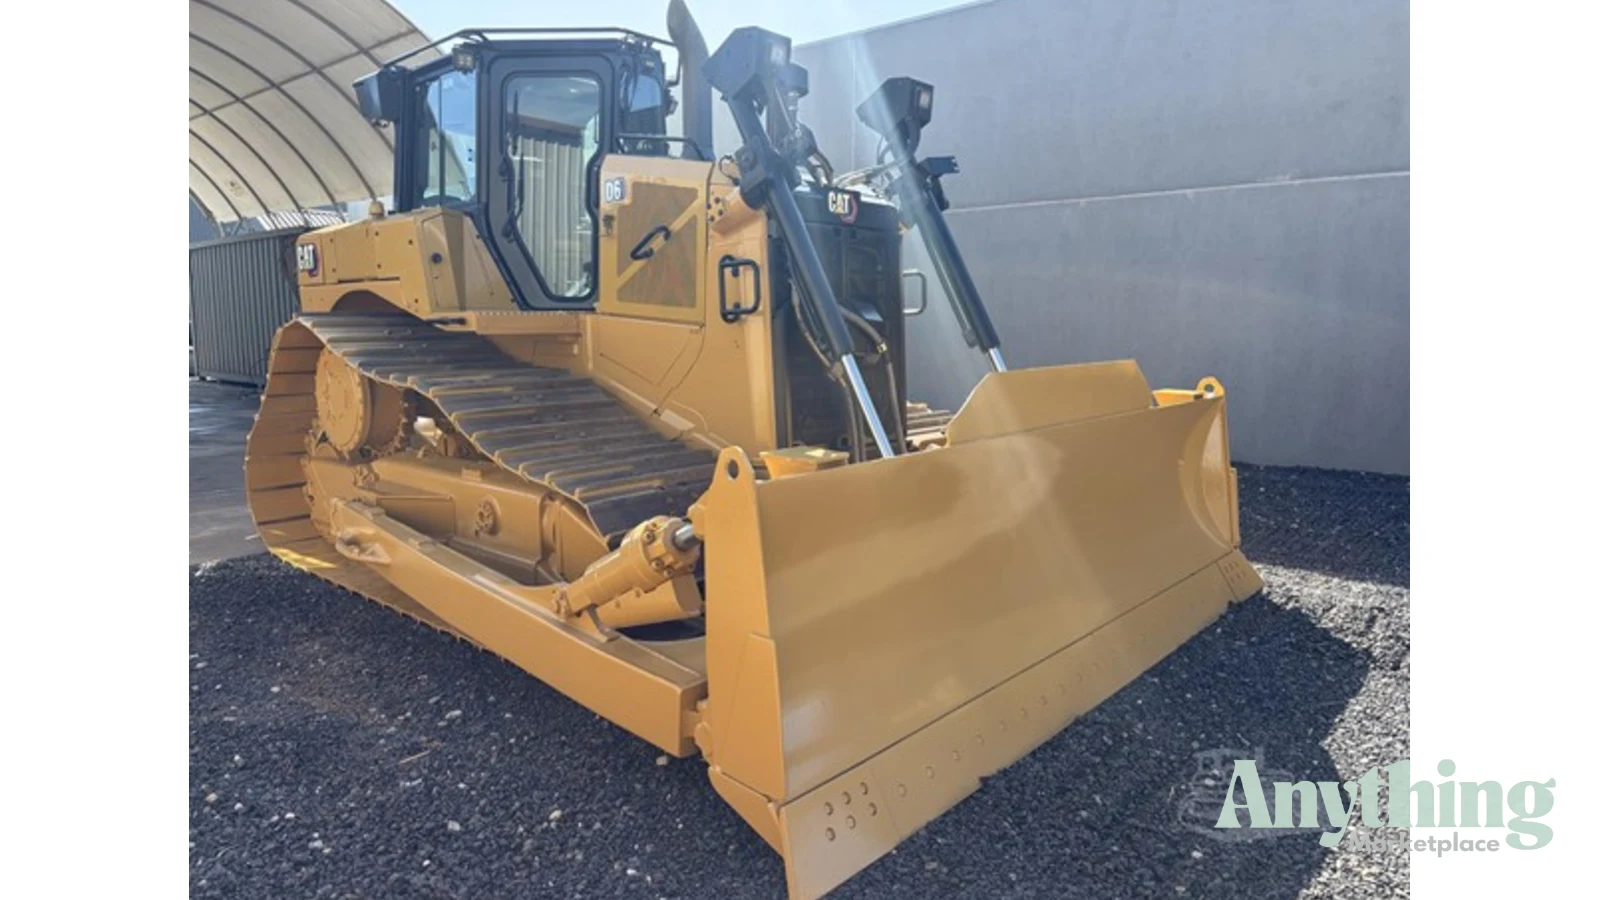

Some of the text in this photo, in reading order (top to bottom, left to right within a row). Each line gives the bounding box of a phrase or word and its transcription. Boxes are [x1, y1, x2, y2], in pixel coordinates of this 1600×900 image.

[605, 180, 622, 201] D6
[828, 191, 850, 214] CAT
[296, 244, 315, 270] CAT
